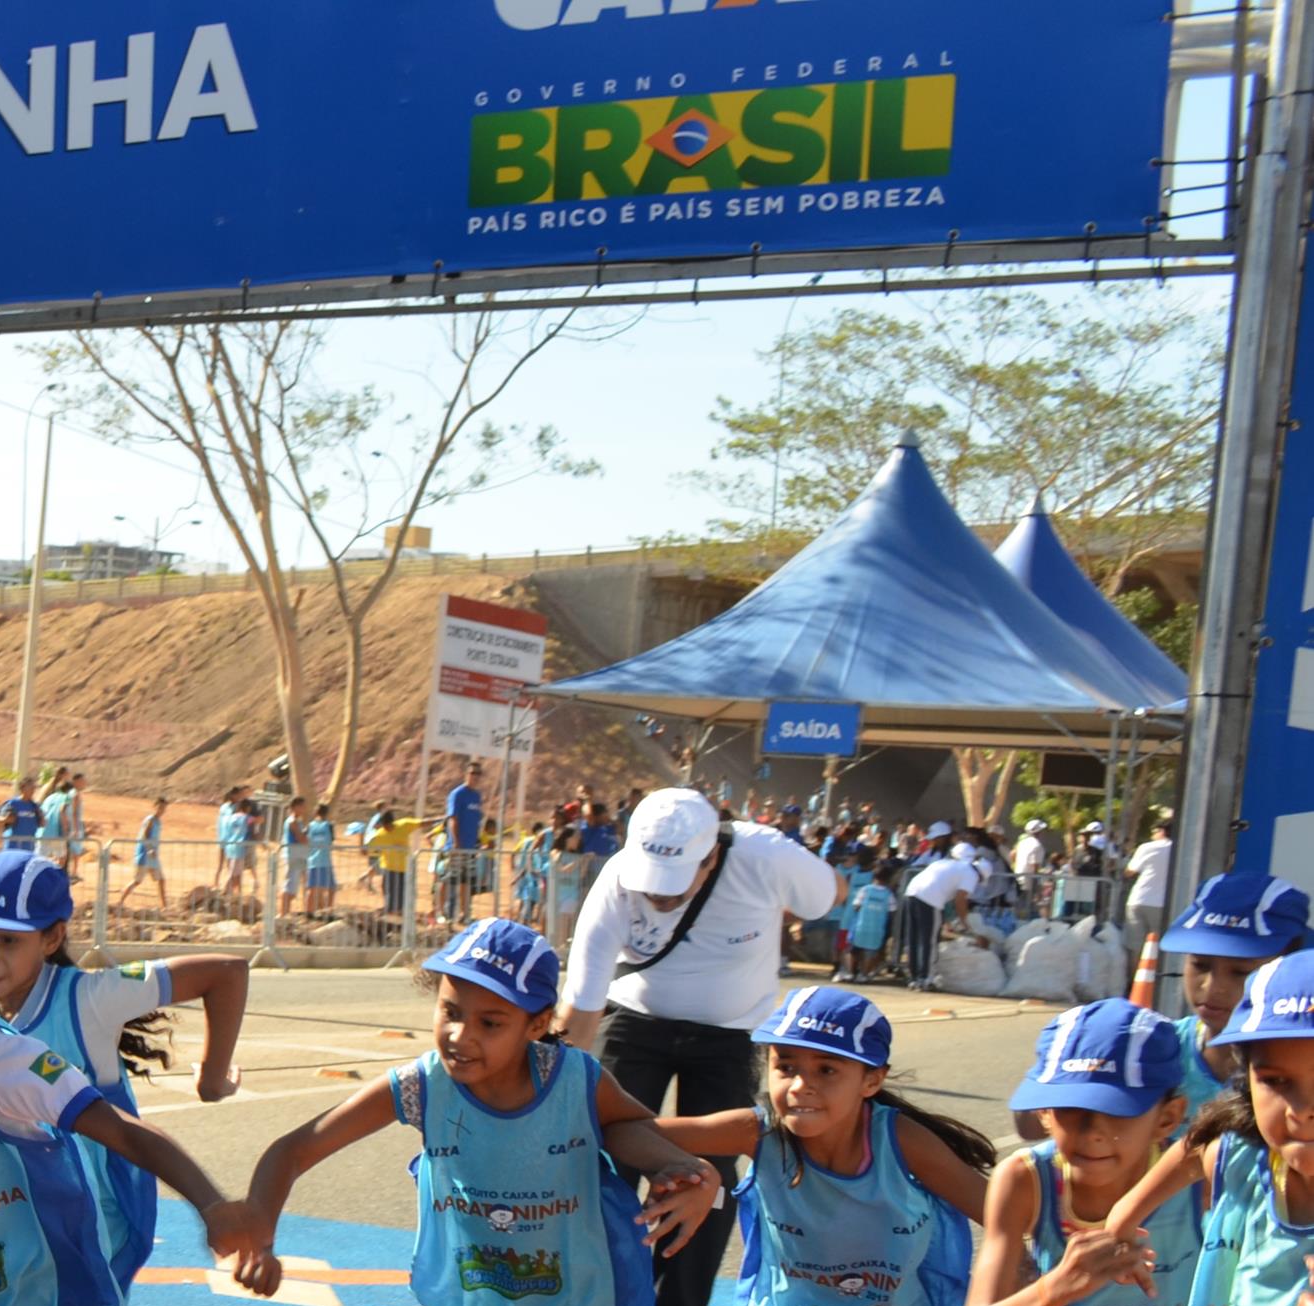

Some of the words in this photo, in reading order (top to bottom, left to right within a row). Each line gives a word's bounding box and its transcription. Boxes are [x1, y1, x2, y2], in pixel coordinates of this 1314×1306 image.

[473, 72, 687, 107] GOVERNO
[731, 50, 954, 83] FEDERAL
[468, 75, 955, 209] BRASIL
[467, 211, 528, 235] PAÍS
[539, 207, 608, 229] RICO
[620, 202, 637, 224] É
[649, 197, 713, 222] PAÍS
[725, 196, 785, 218] SEM
[797, 185, 947, 214] POBREZA
[779, 718, 842, 740] SAÍDA
[641, 842, 684, 857] CAIXA
[1203, 912, 1251, 929] CAIXA
[727, 930, 762, 946] CAIXA
[471, 947, 515, 976] CAIXA
[797, 1015, 846, 1038] CAIXA
[1062, 1057, 1117, 1074] CAIXA
[547, 1137, 587, 1156] CAIXA
[501, 1190, 538, 1200] CAIXA
[517, 1223, 545, 1233] 2012
[891, 1212, 930, 1236] CAIXA
[795, 1260, 848, 1272] CIRCUITO
[851, 1259, 887, 1269] CAIXA
